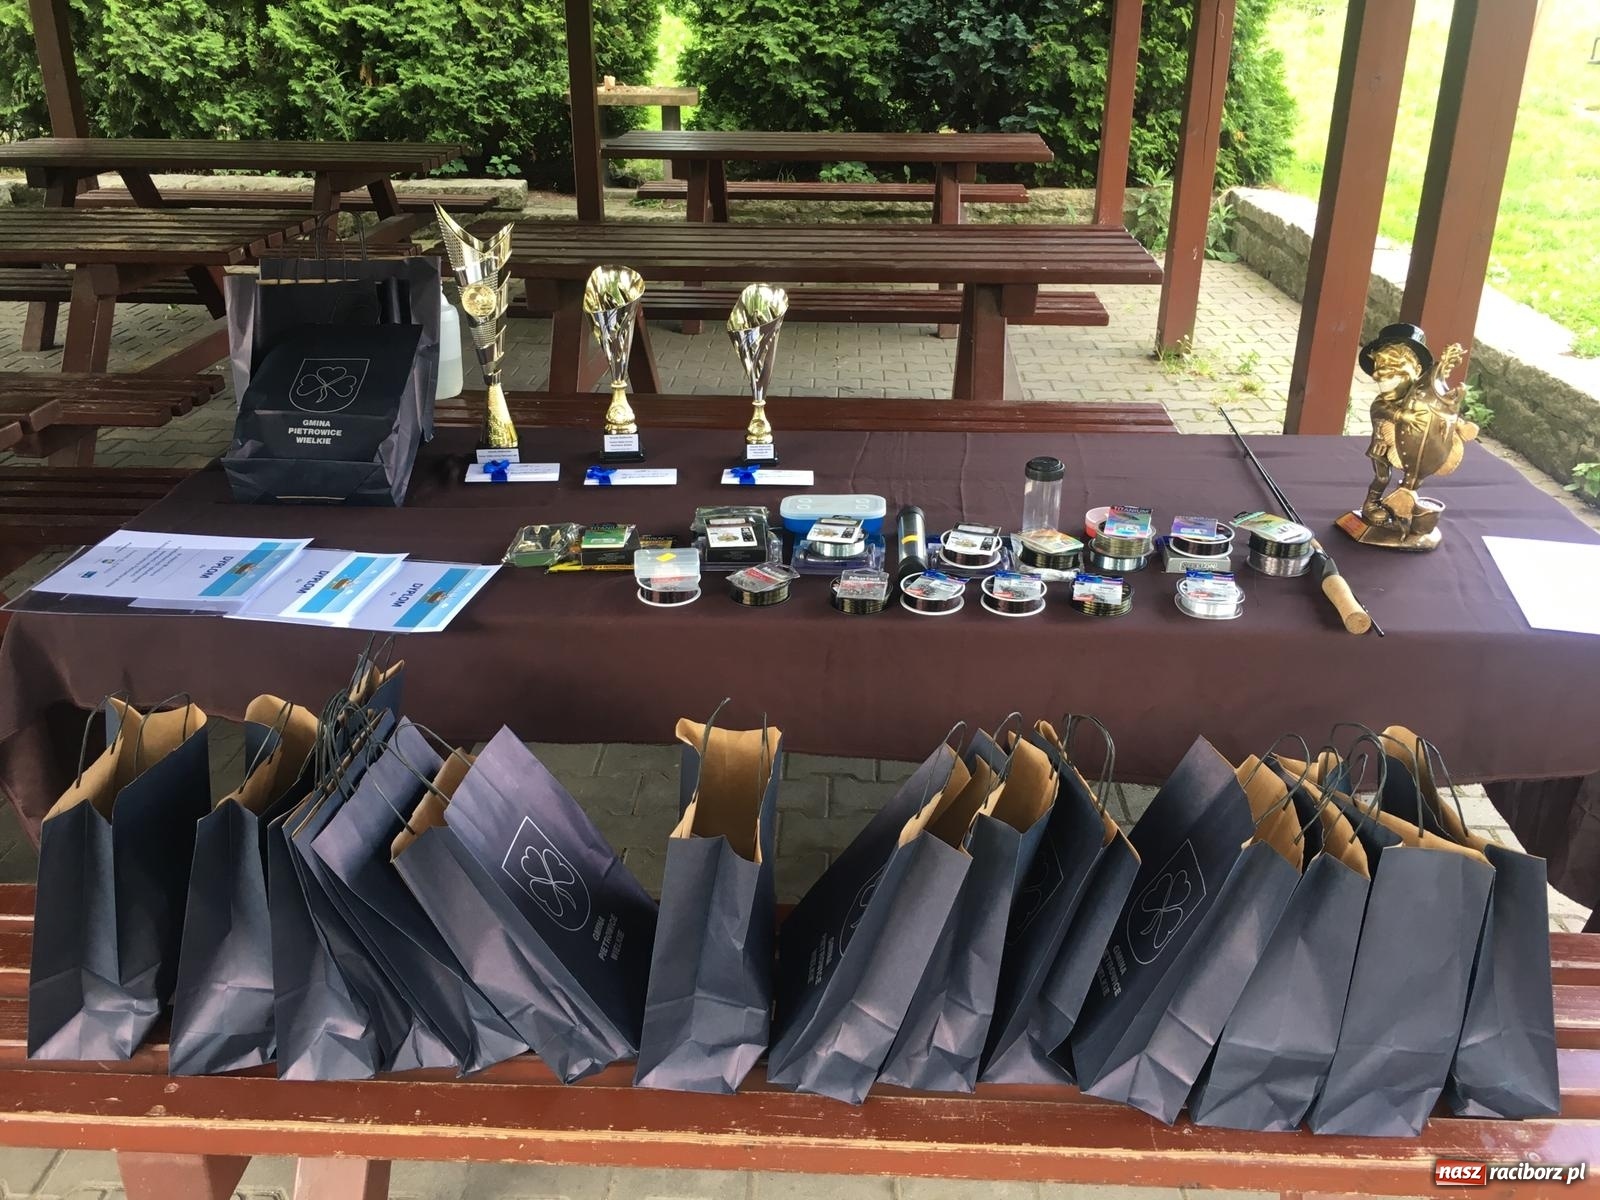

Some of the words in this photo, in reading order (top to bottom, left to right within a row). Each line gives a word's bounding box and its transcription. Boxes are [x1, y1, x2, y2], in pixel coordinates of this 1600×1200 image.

[302, 419, 331, 427] GMINA
[288, 427, 343, 436] PIETROWICE
[296, 436, 332, 444] WIELKIE
[199, 555, 234, 579] DYPLOM
[297, 570, 330, 594] DYPLOM
[391, 582, 423, 608] DYPLOM
